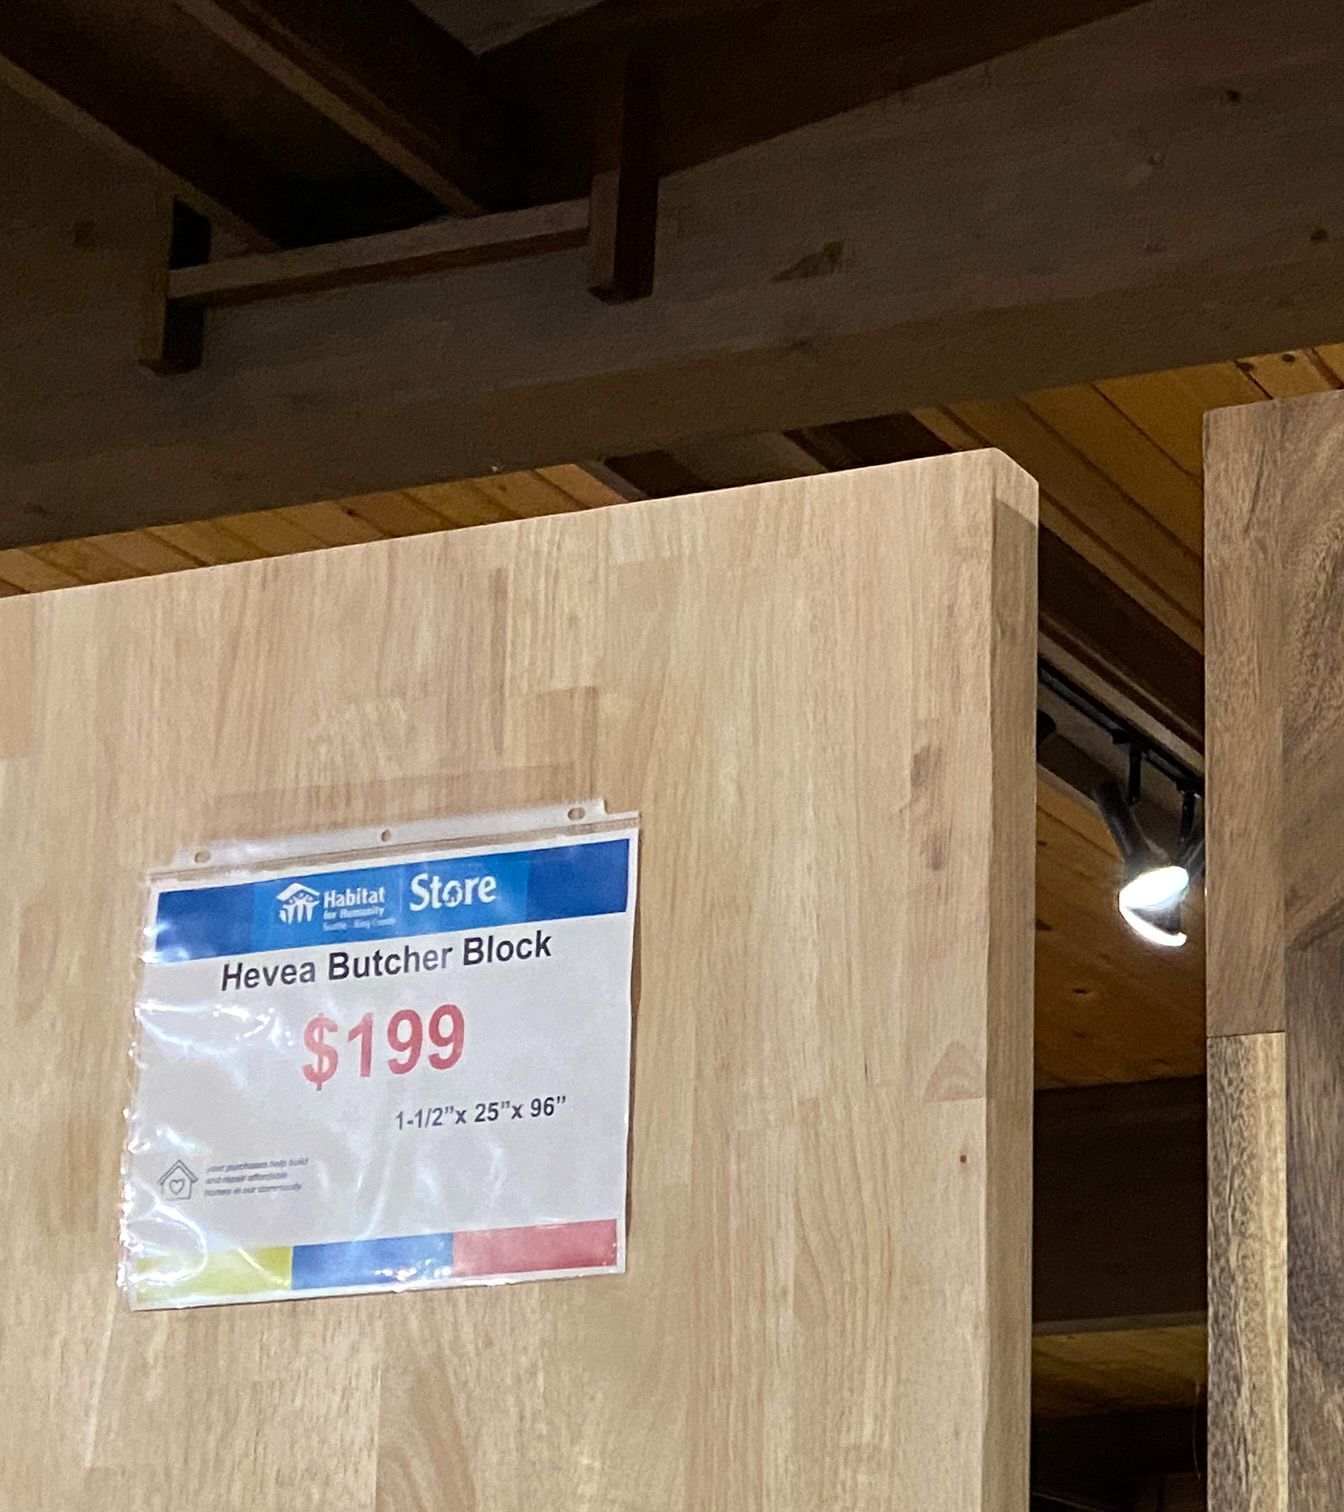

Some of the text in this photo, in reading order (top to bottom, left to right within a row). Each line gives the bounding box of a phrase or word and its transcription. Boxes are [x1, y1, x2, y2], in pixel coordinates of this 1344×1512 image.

[323, 886, 385, 909] Habitat
[409, 872, 497, 912] Store
[220, 930, 552, 992] Hevea Butcher Block
[301, 1004, 466, 1091] $199
